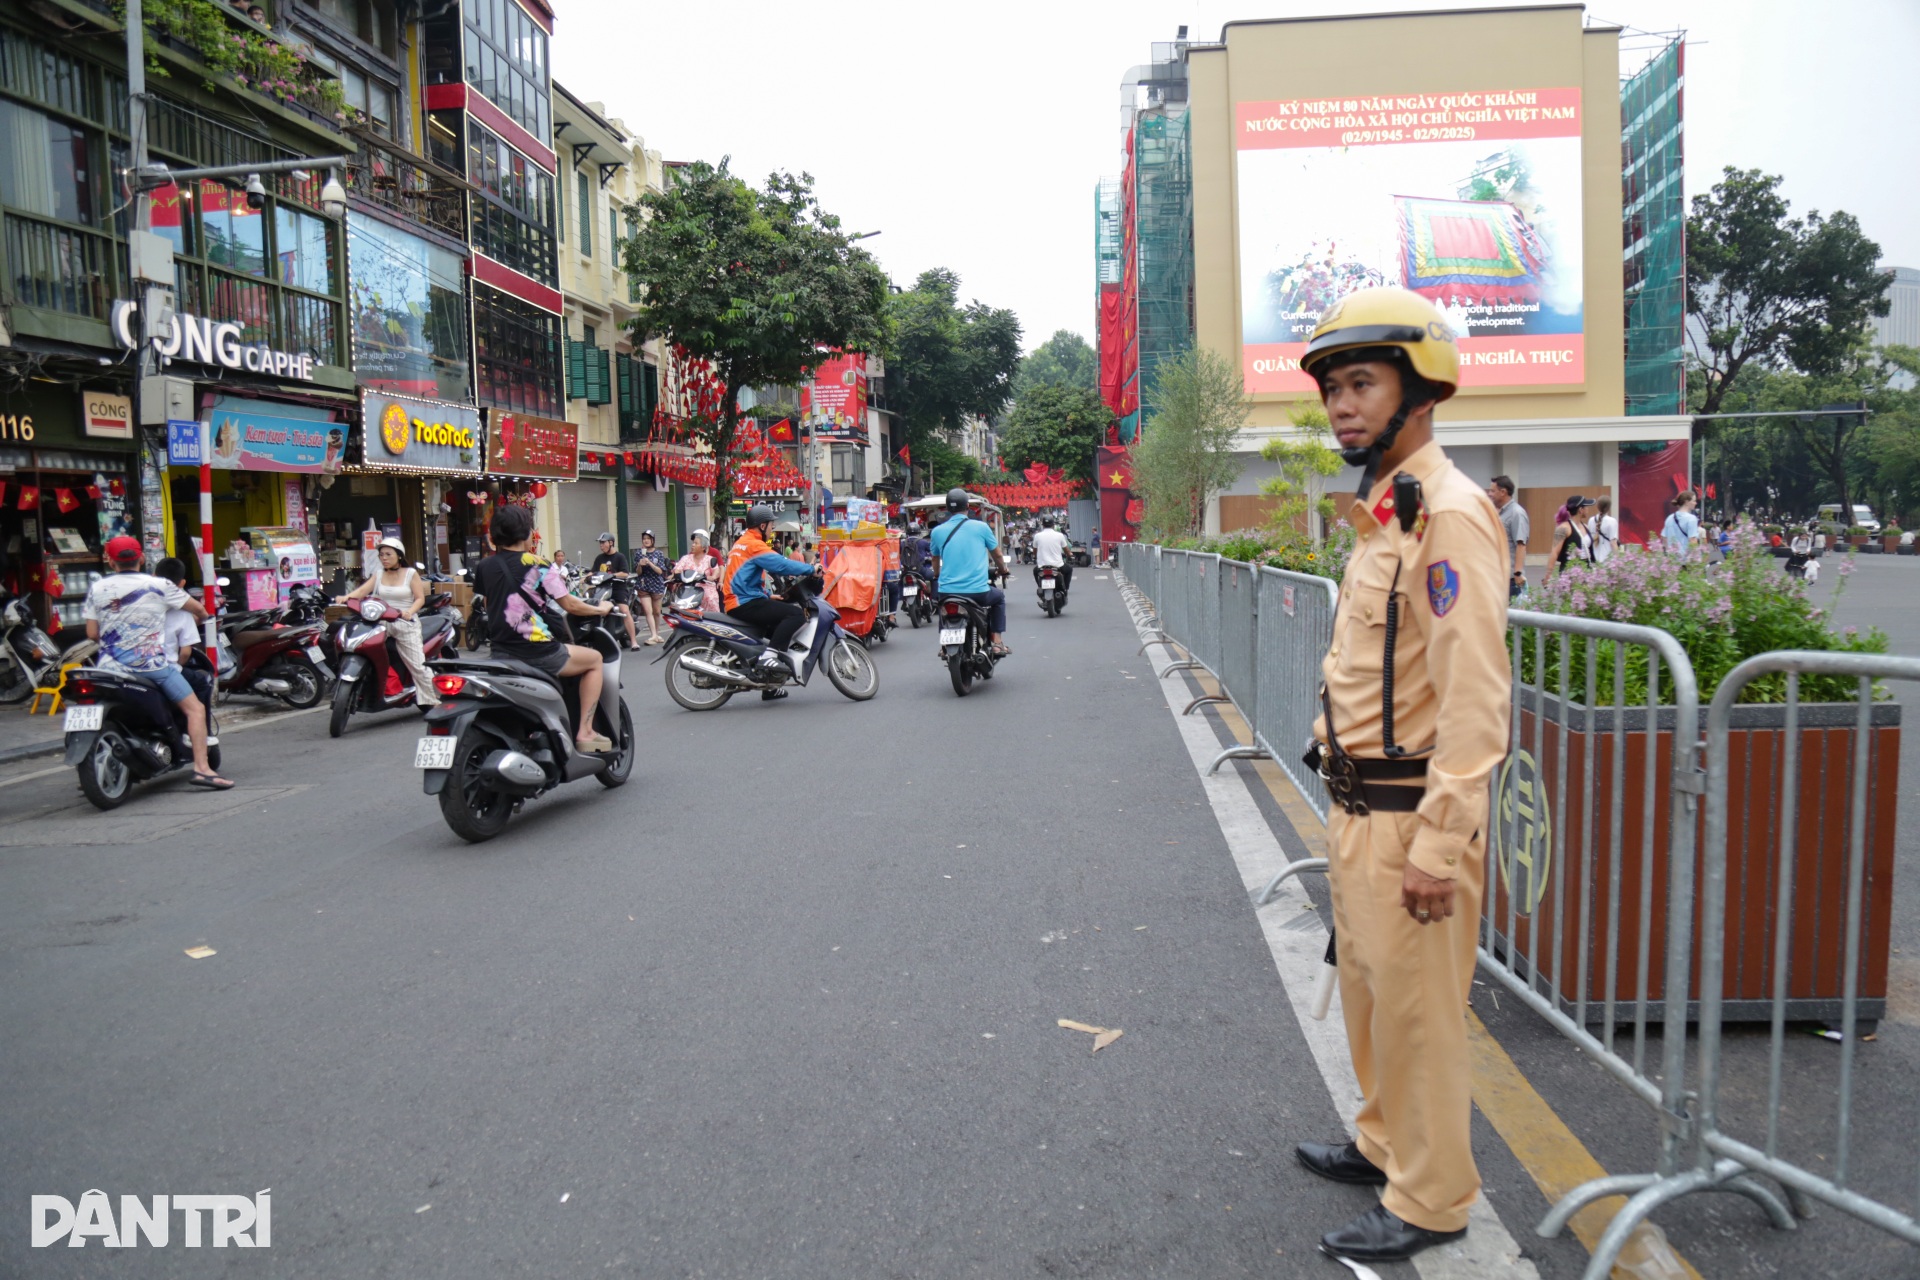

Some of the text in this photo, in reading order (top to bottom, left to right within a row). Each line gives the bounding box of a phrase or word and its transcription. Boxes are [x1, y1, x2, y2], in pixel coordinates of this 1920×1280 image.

[1279, 91, 1537, 116] KỶ NIỆM 80 NĂM NGÀY QUỐC KHÁNH
[1246, 107, 1575, 132] NƯỚC CỘNG HÒA XÃ HỘI CHỦ NGHĨA VIỆT NAM
[1341, 130, 1403, 145] (02/9/1945
[1413, 127, 1475, 141] 02/9/2025)
[1280, 309, 1322, 321] Currently
[1494, 302, 1540, 313] traditional
[1466, 316, 1525, 328] development.
[1253, 356, 1302, 374] QUẢN
[1475, 349, 1526, 364] NGHĨA
[1529, 350, 1573, 366] THỤC
[0, 414, 35, 441] 116
[245, 425, 267, 442] Kem
[421, 738, 450, 753] 29-C1
[416, 752, 451, 767] 895.70
